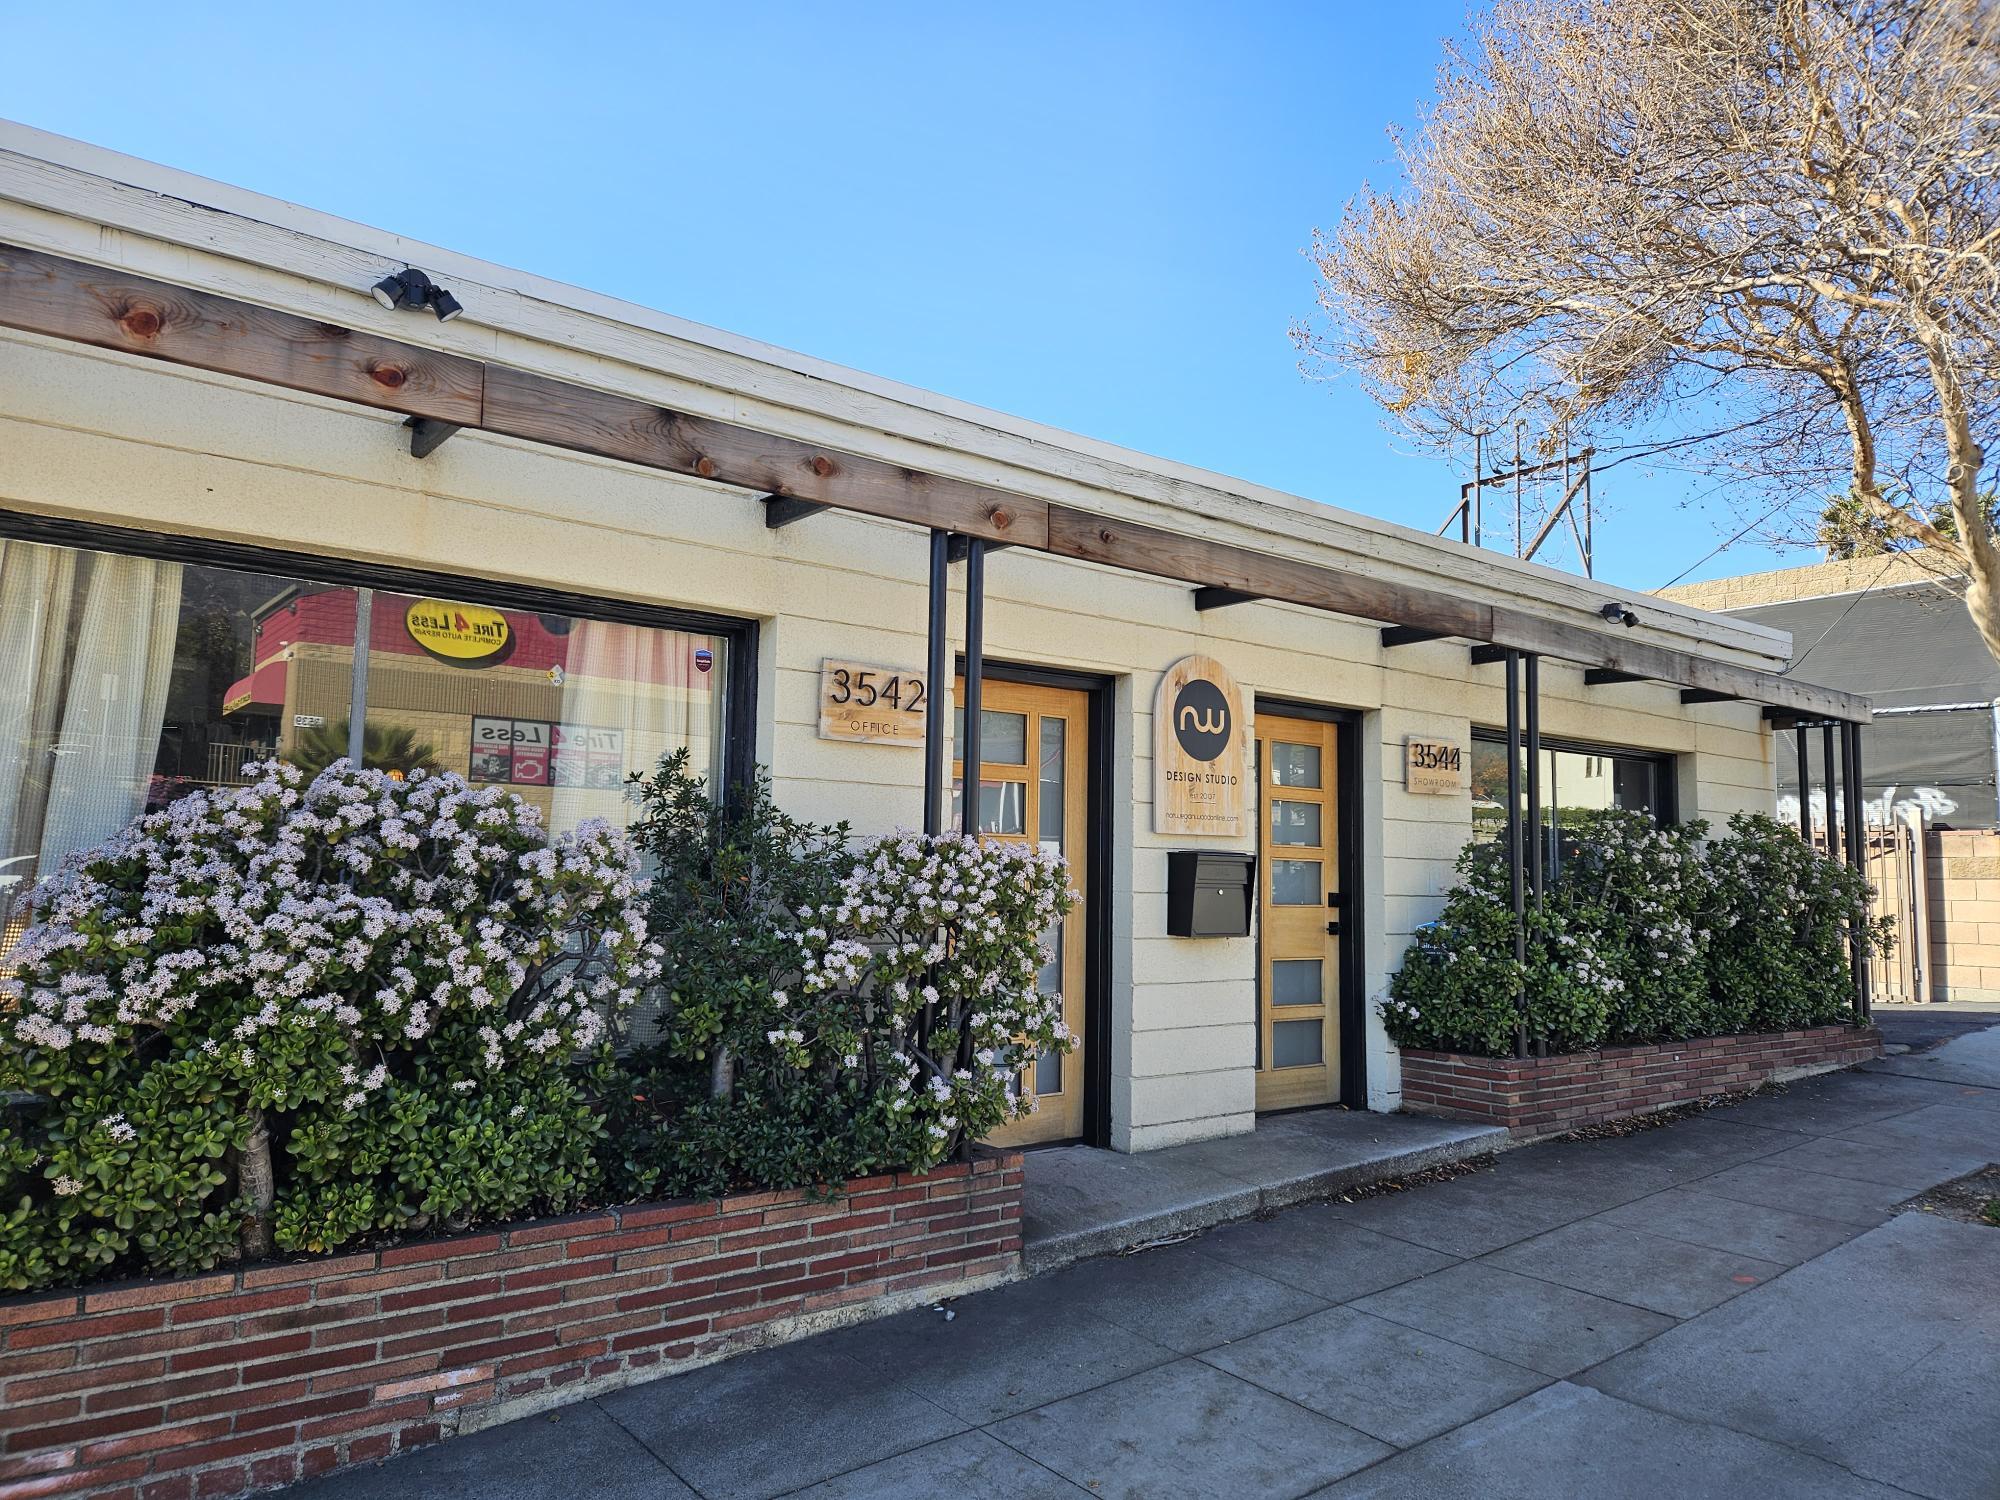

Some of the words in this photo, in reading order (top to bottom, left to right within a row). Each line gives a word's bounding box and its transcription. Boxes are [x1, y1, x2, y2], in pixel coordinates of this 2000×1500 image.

[831, 669, 925, 713] 3542
[850, 720, 899, 736] OFFICE
[1411, 743, 1462, 771] 3544
[1166, 770, 1202, 783] DESIGN
[1205, 773, 1238, 786] STUDIO
[1413, 777, 1457, 788] SHOWROOM
